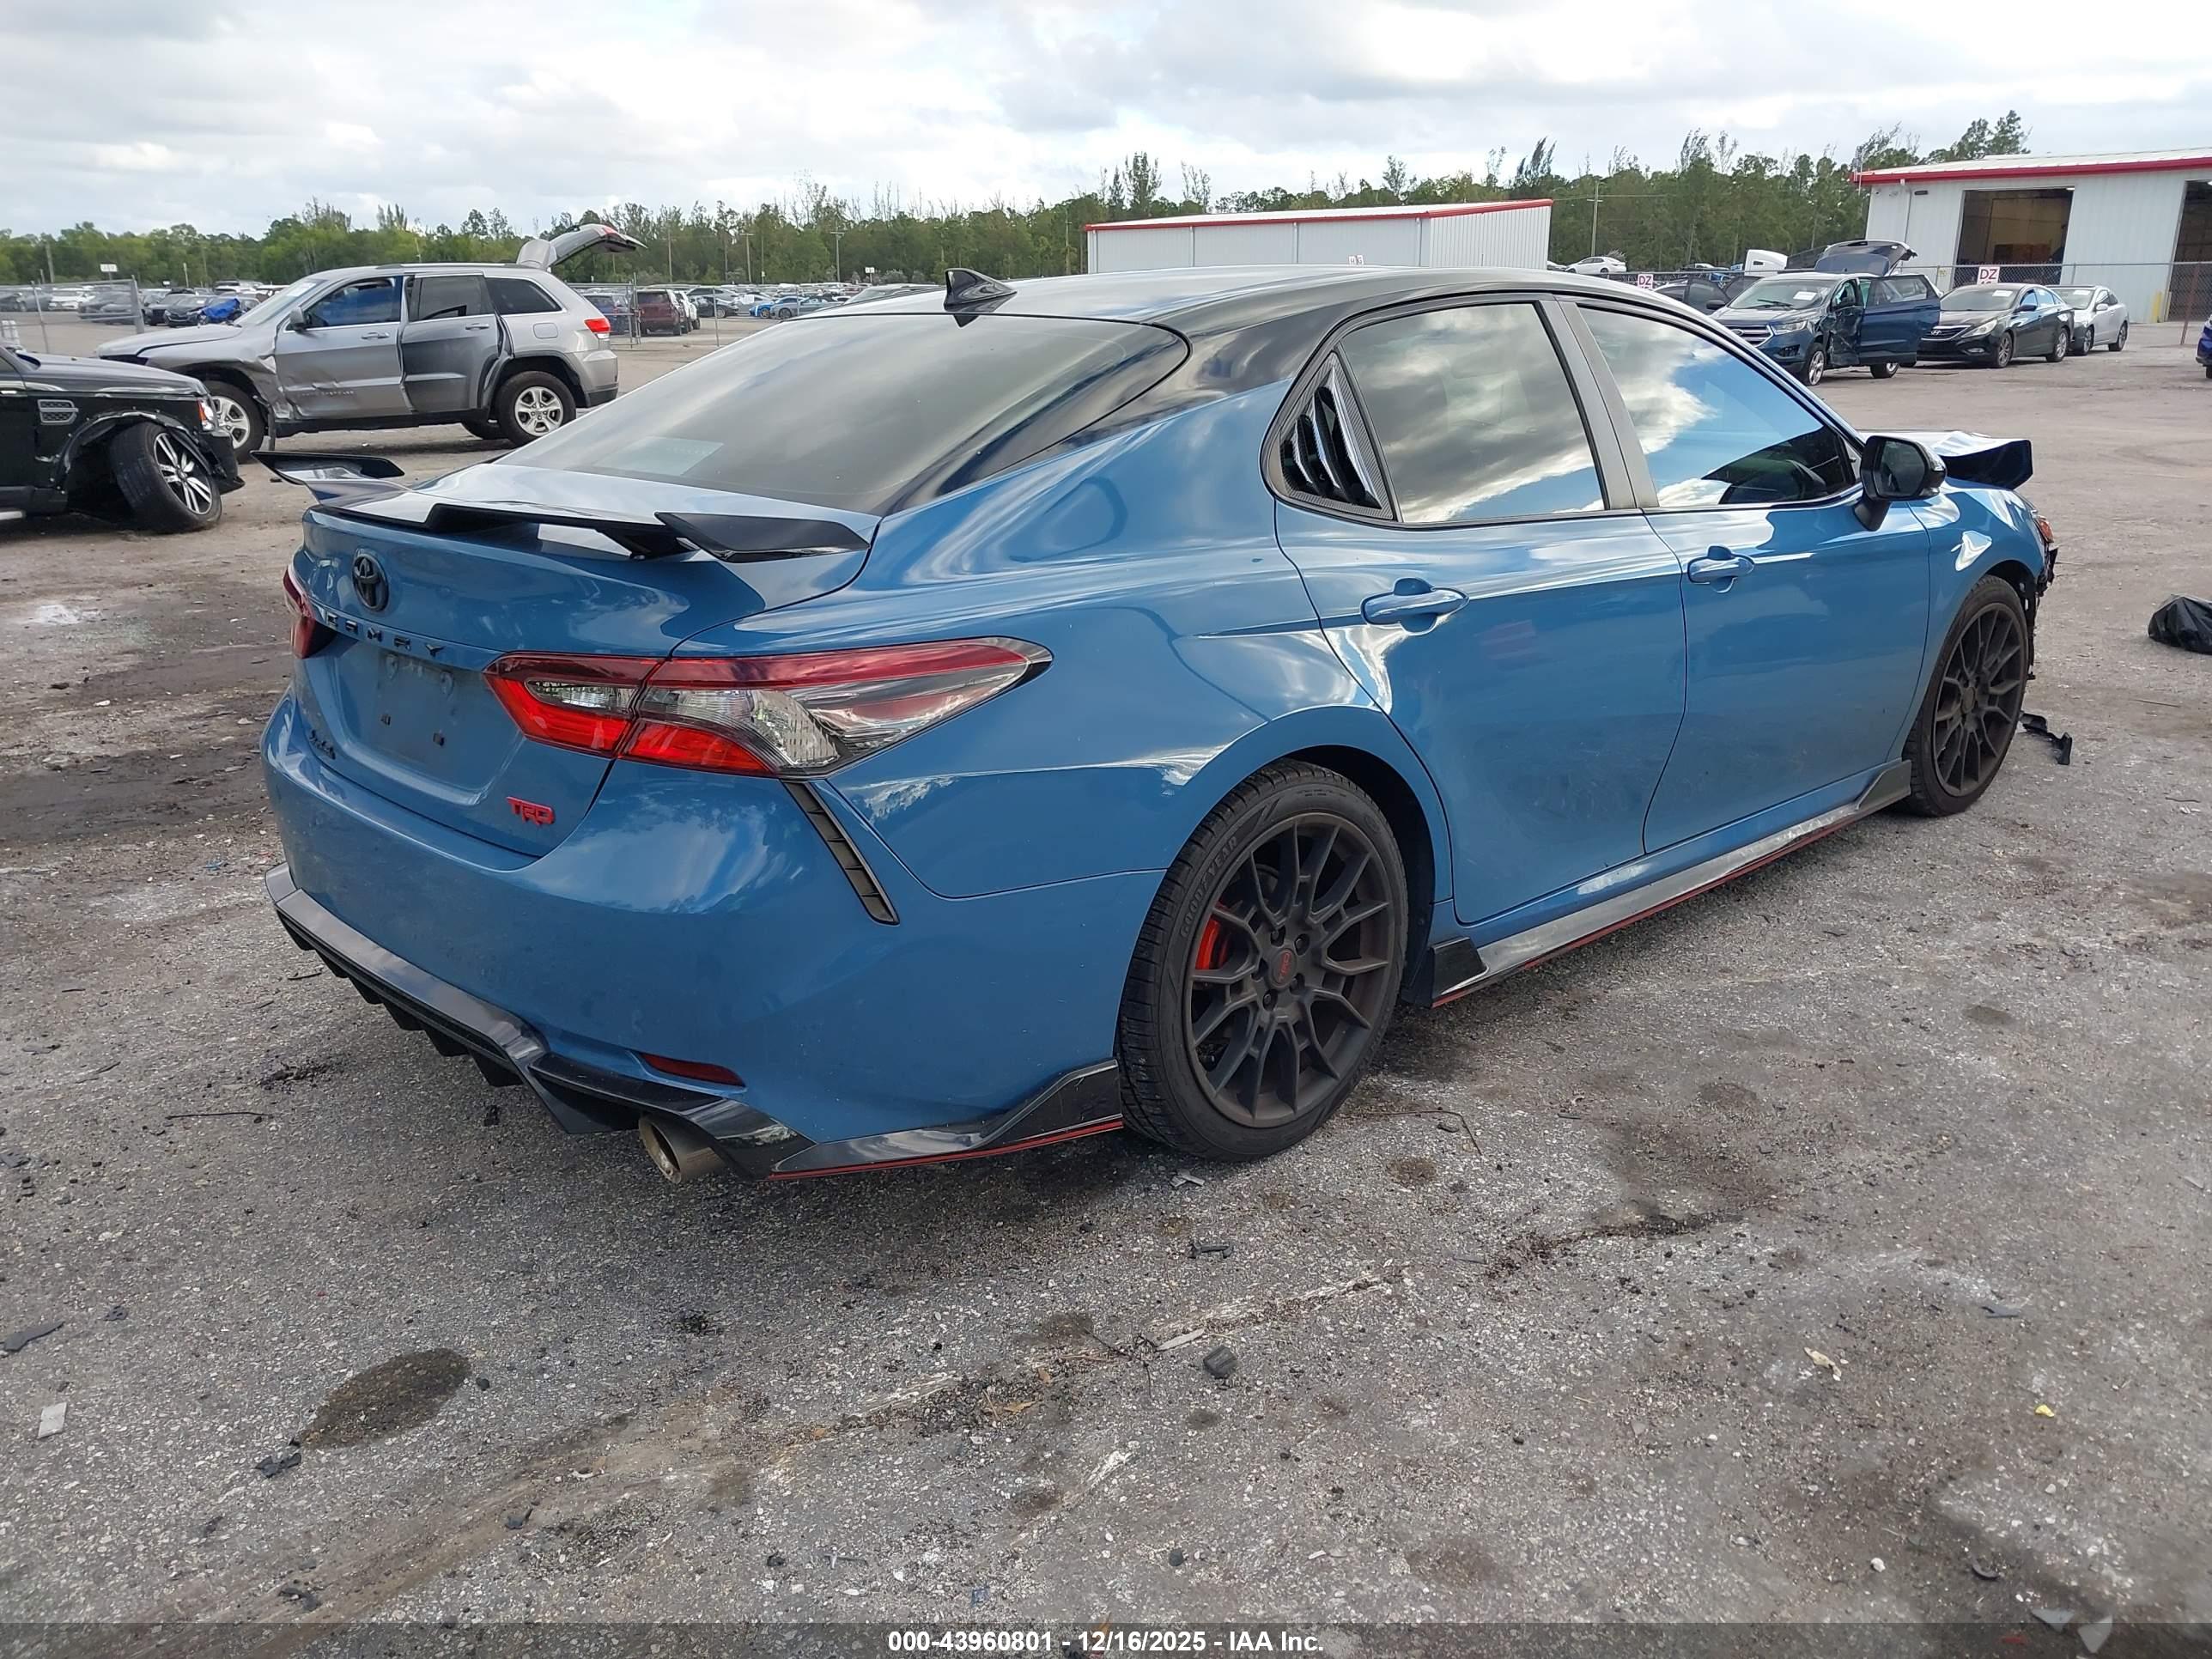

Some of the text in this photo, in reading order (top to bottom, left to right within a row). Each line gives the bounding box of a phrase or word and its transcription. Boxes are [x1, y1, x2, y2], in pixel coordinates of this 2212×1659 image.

[1639, 276, 1651, 285] DZ
[1979, 269, 1997, 279] DZ
[506, 796, 556, 828] TRD
[1180, 836, 1237, 938] GOODYEAR
